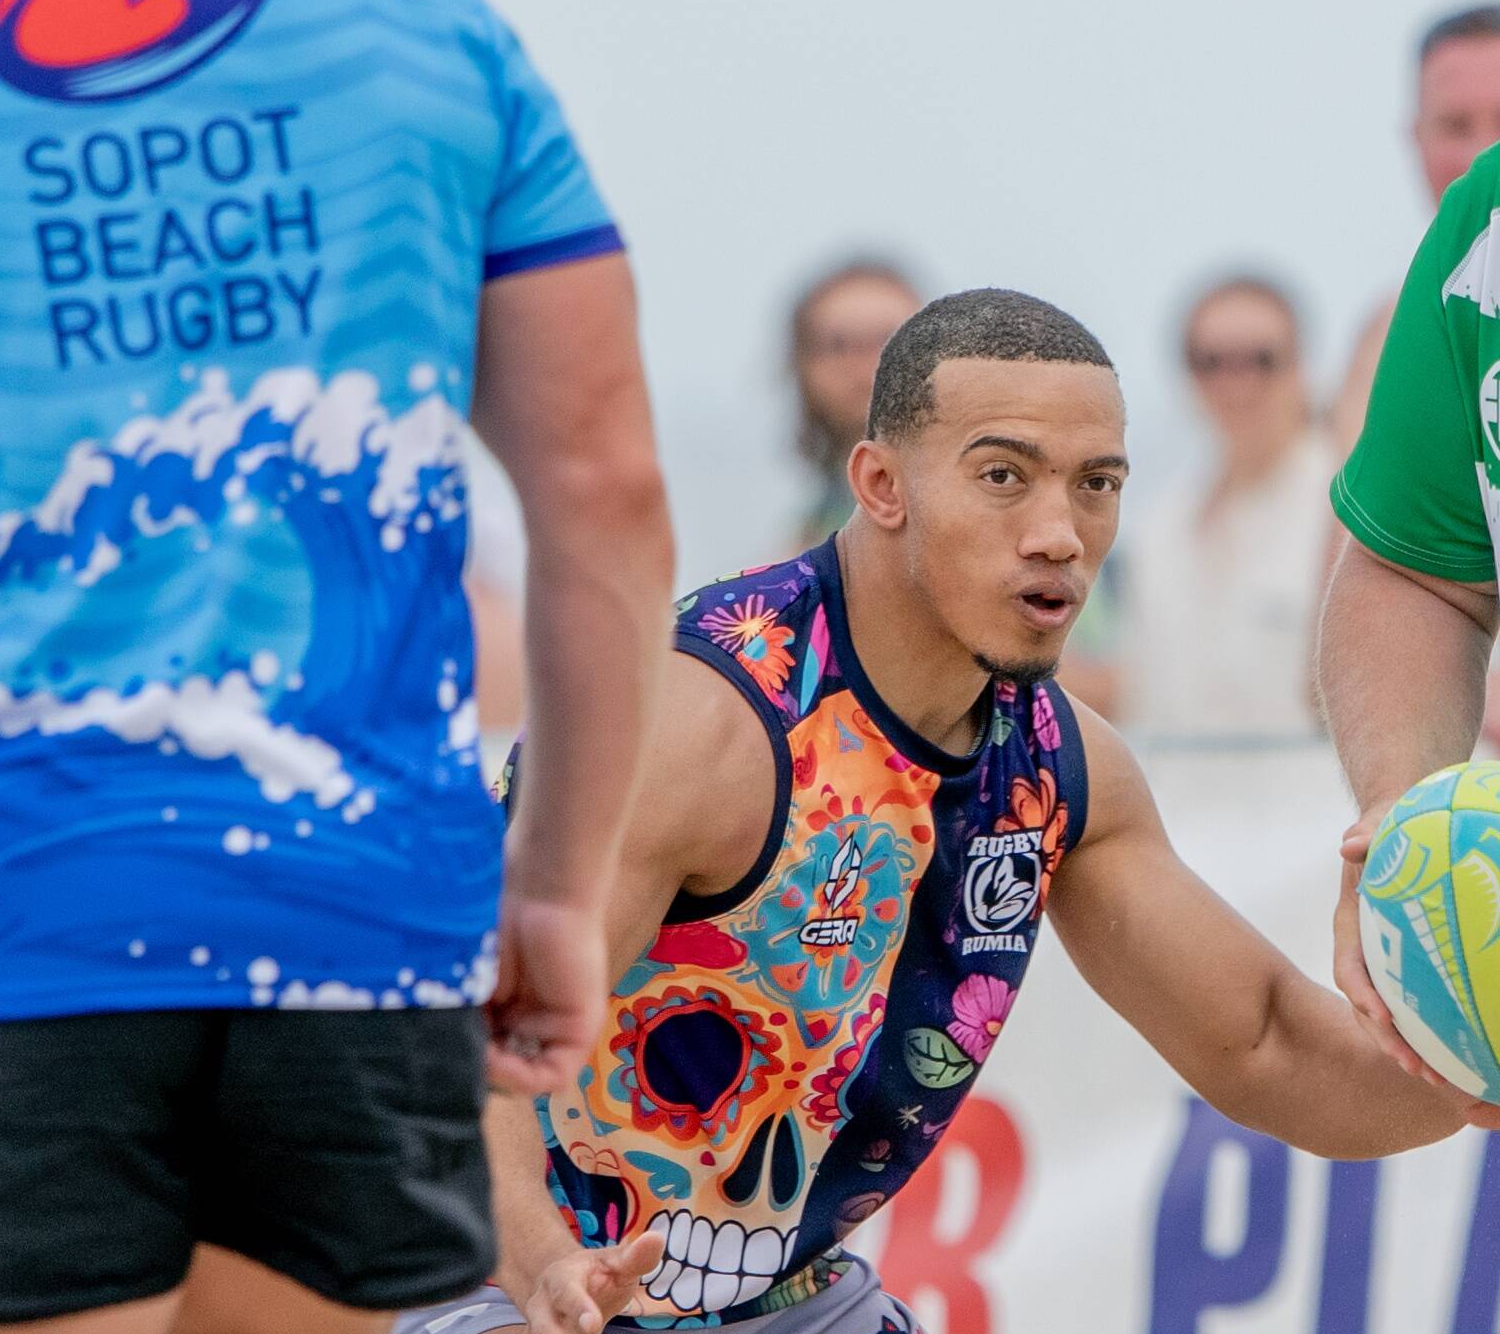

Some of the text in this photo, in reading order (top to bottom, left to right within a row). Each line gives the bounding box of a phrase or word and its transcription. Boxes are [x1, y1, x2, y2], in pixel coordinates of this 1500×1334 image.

[23, 105, 301, 207] SOPOT
[35, 182, 320, 288] BEACH
[50, 265, 323, 370] RUGBY
[967, 831, 1043, 857] RUGBY
[962, 935, 1028, 955] RUMIA
